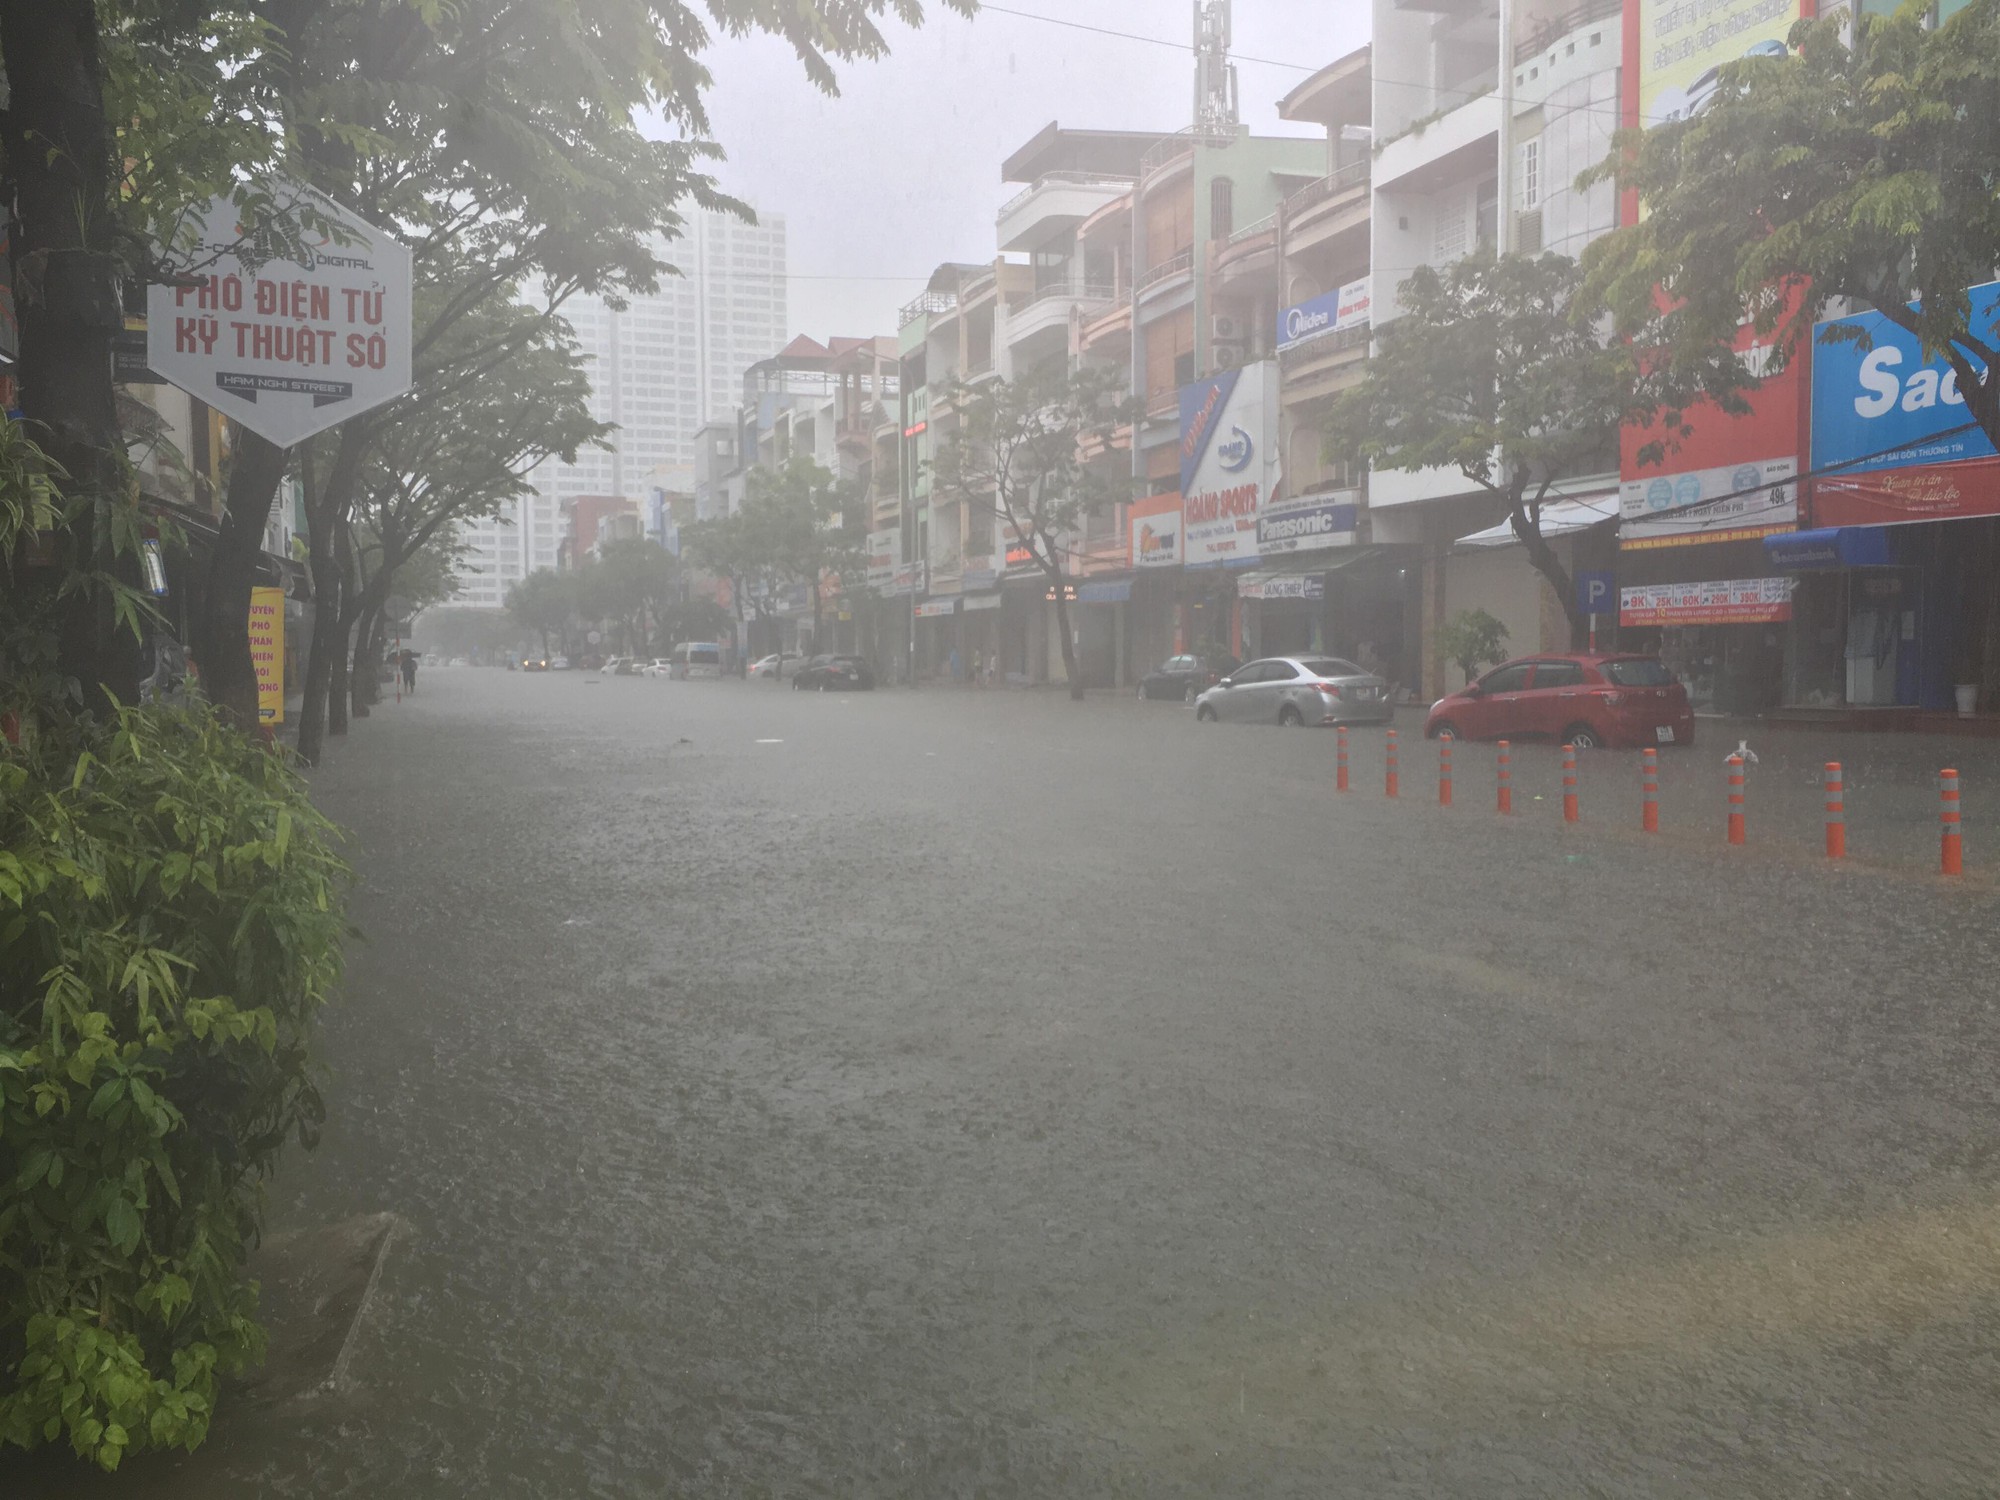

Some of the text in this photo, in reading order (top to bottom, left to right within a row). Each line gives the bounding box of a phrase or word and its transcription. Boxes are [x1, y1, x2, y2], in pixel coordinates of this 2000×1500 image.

[316, 254, 375, 271] DIGITAL
[254, 279, 330, 322] ĐIỆN
[341, 281, 387, 325] TỬ
[176, 313, 387, 370] KỸ THUẬT SỐ
[224, 374, 345, 394] HAM NGHI STREET
[1186, 483, 1259, 524] HOÀNG SPORTS
[1260, 510, 1333, 542] Panasonic
[1589, 580, 1606, 604] P
